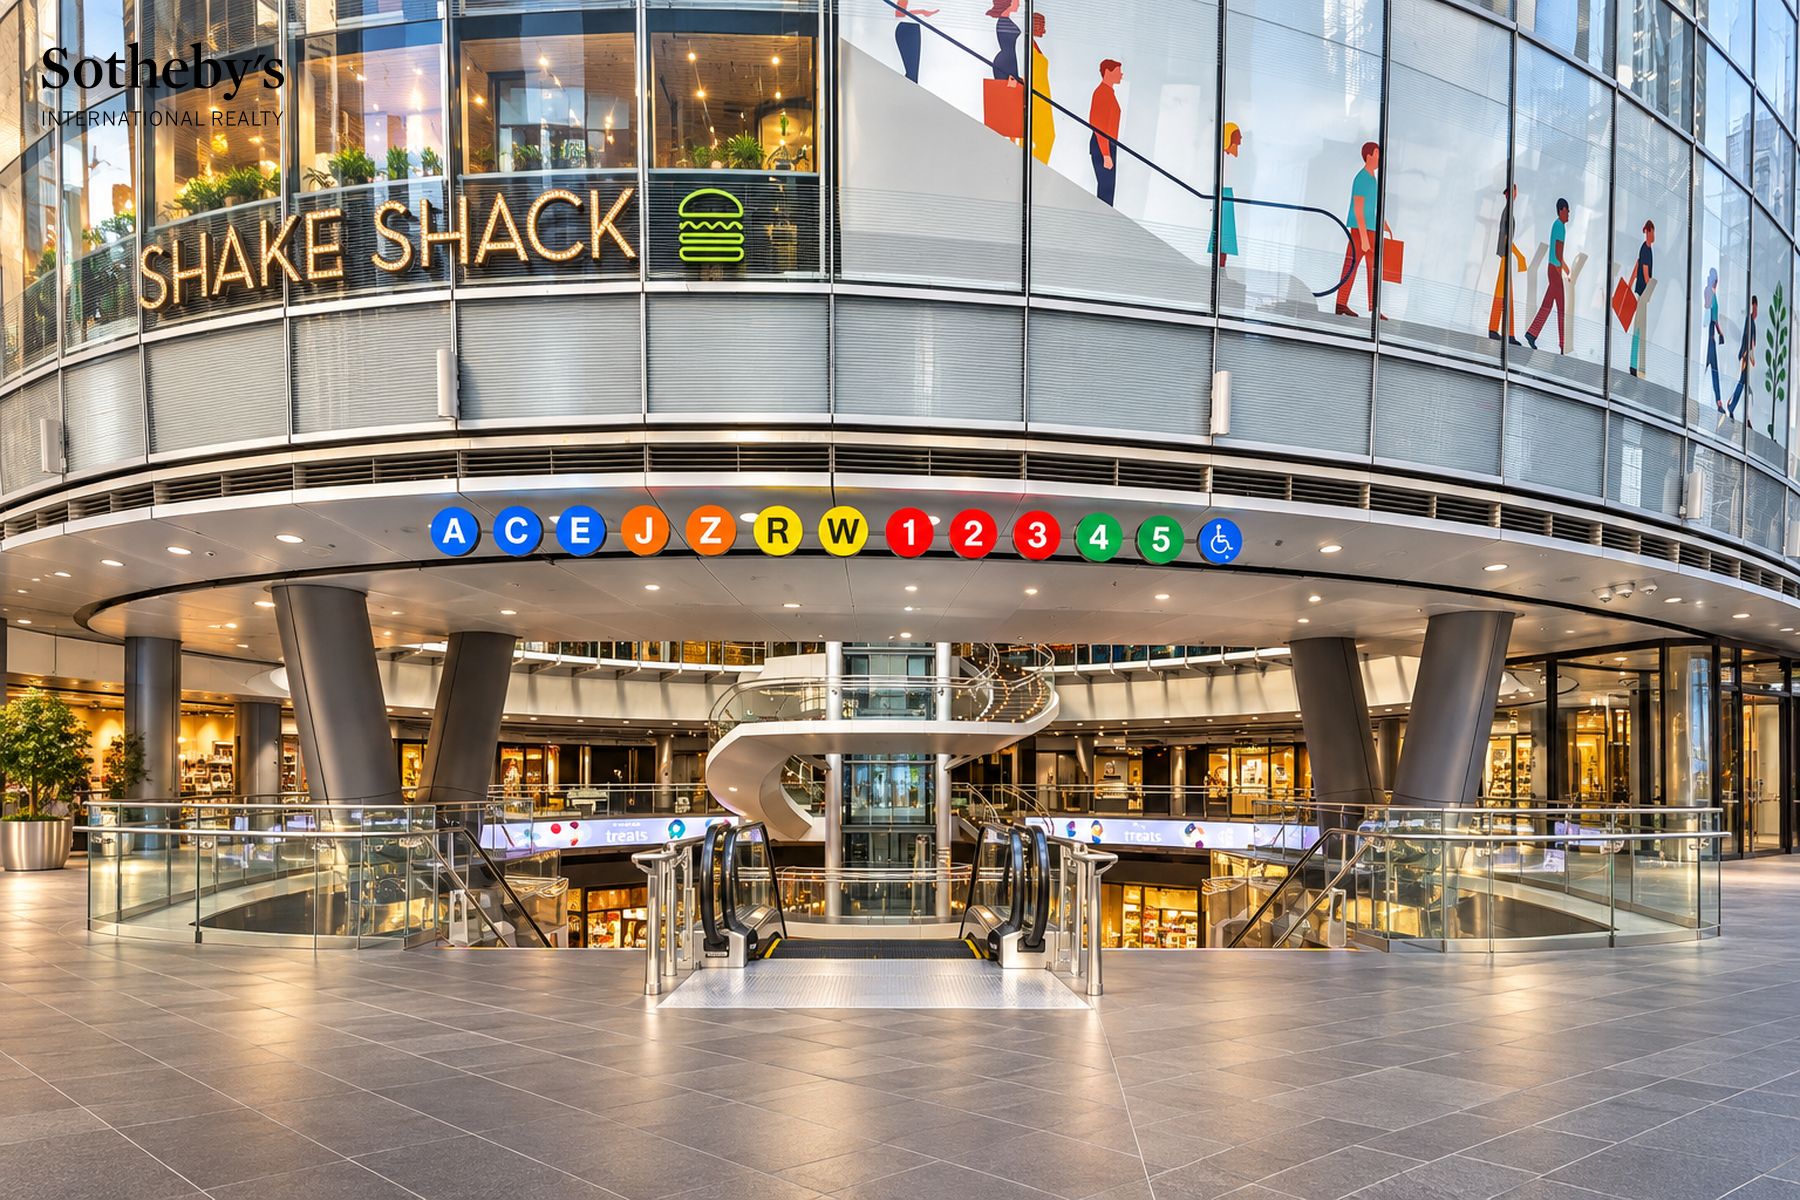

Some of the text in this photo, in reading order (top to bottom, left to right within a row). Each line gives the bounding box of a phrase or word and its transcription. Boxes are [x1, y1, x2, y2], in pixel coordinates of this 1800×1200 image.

[139, 187, 637, 309] SHAKE SHACK
[442, 516, 1171, 552] A C E J Z R W 1 2 3 4 5
[605, 829, 648, 843] treats
